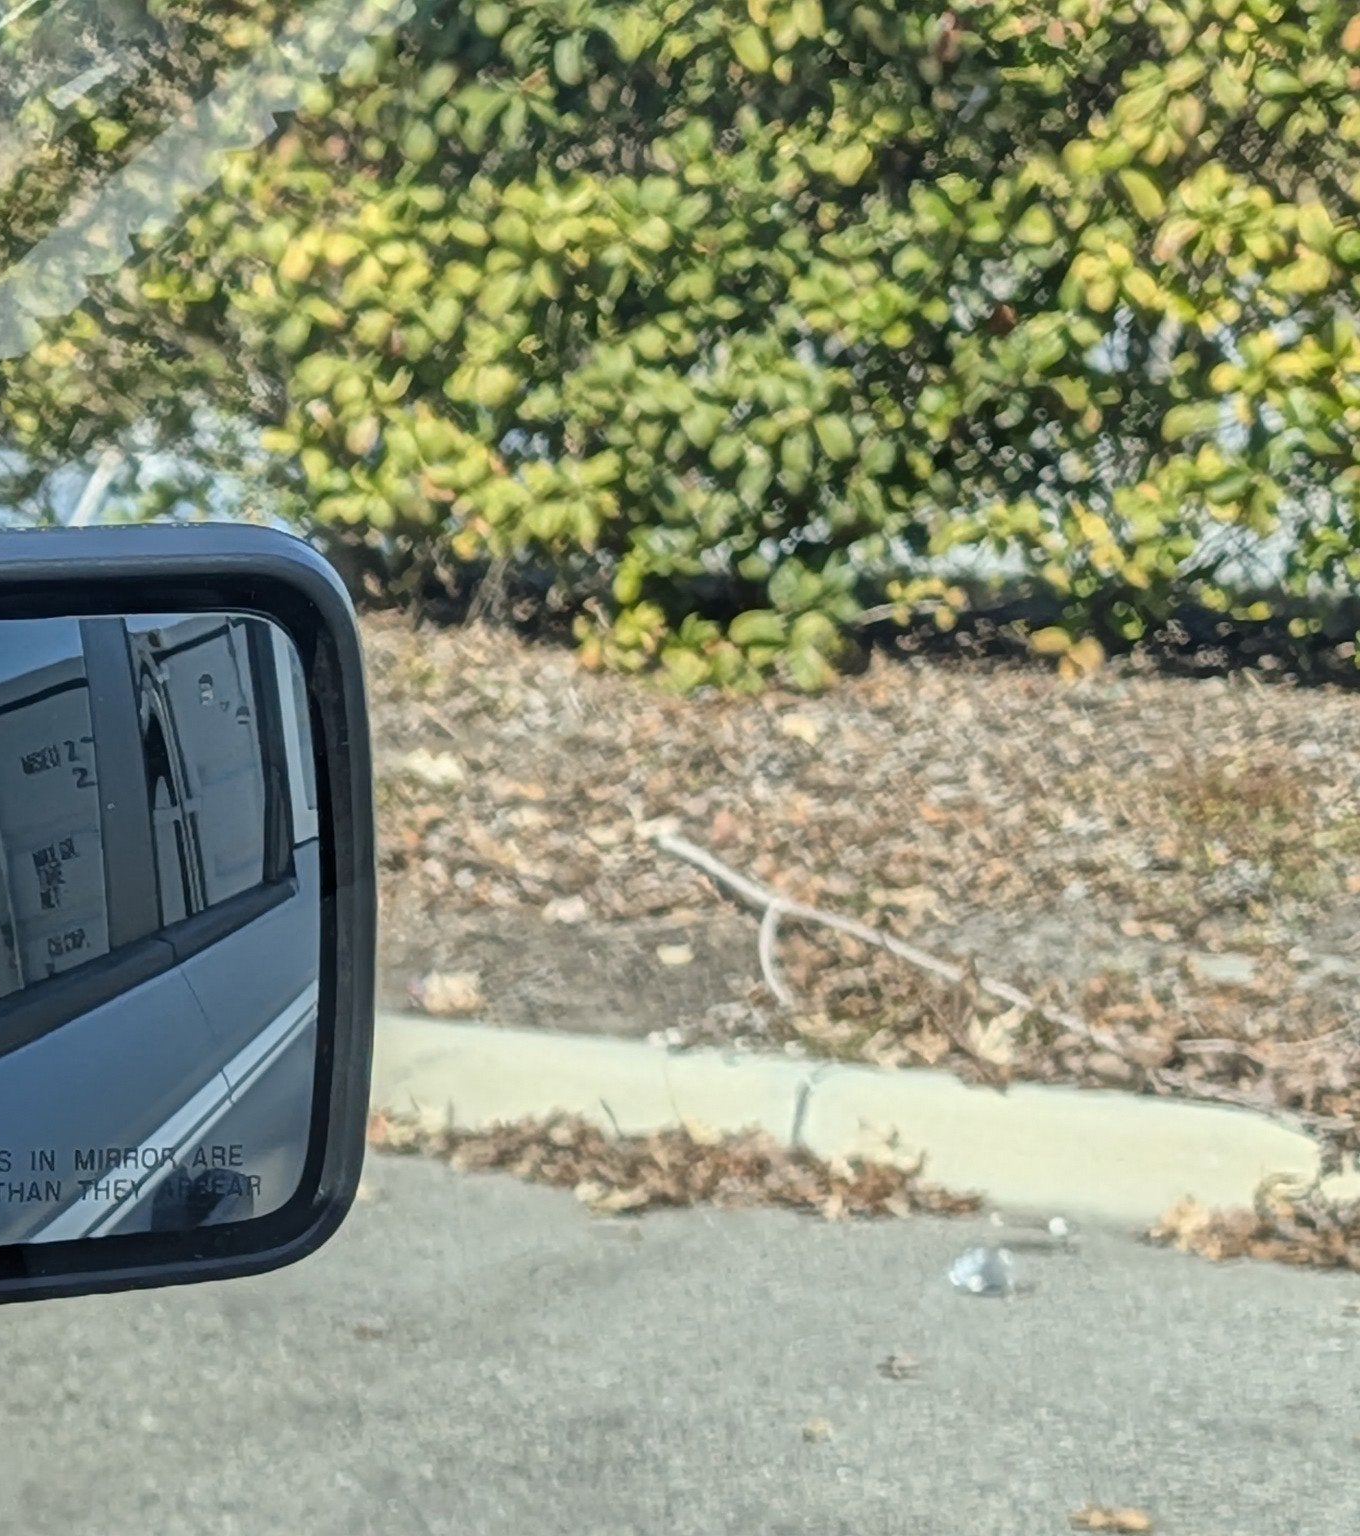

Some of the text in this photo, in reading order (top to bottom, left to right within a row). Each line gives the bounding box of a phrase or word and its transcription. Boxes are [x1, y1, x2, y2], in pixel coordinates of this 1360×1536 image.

[30, 1149, 55, 1171] IN
[74, 1147, 178, 1171] MIRROR
[191, 1144, 243, 1168] ARE
[77, 1178, 145, 1201] THEY
